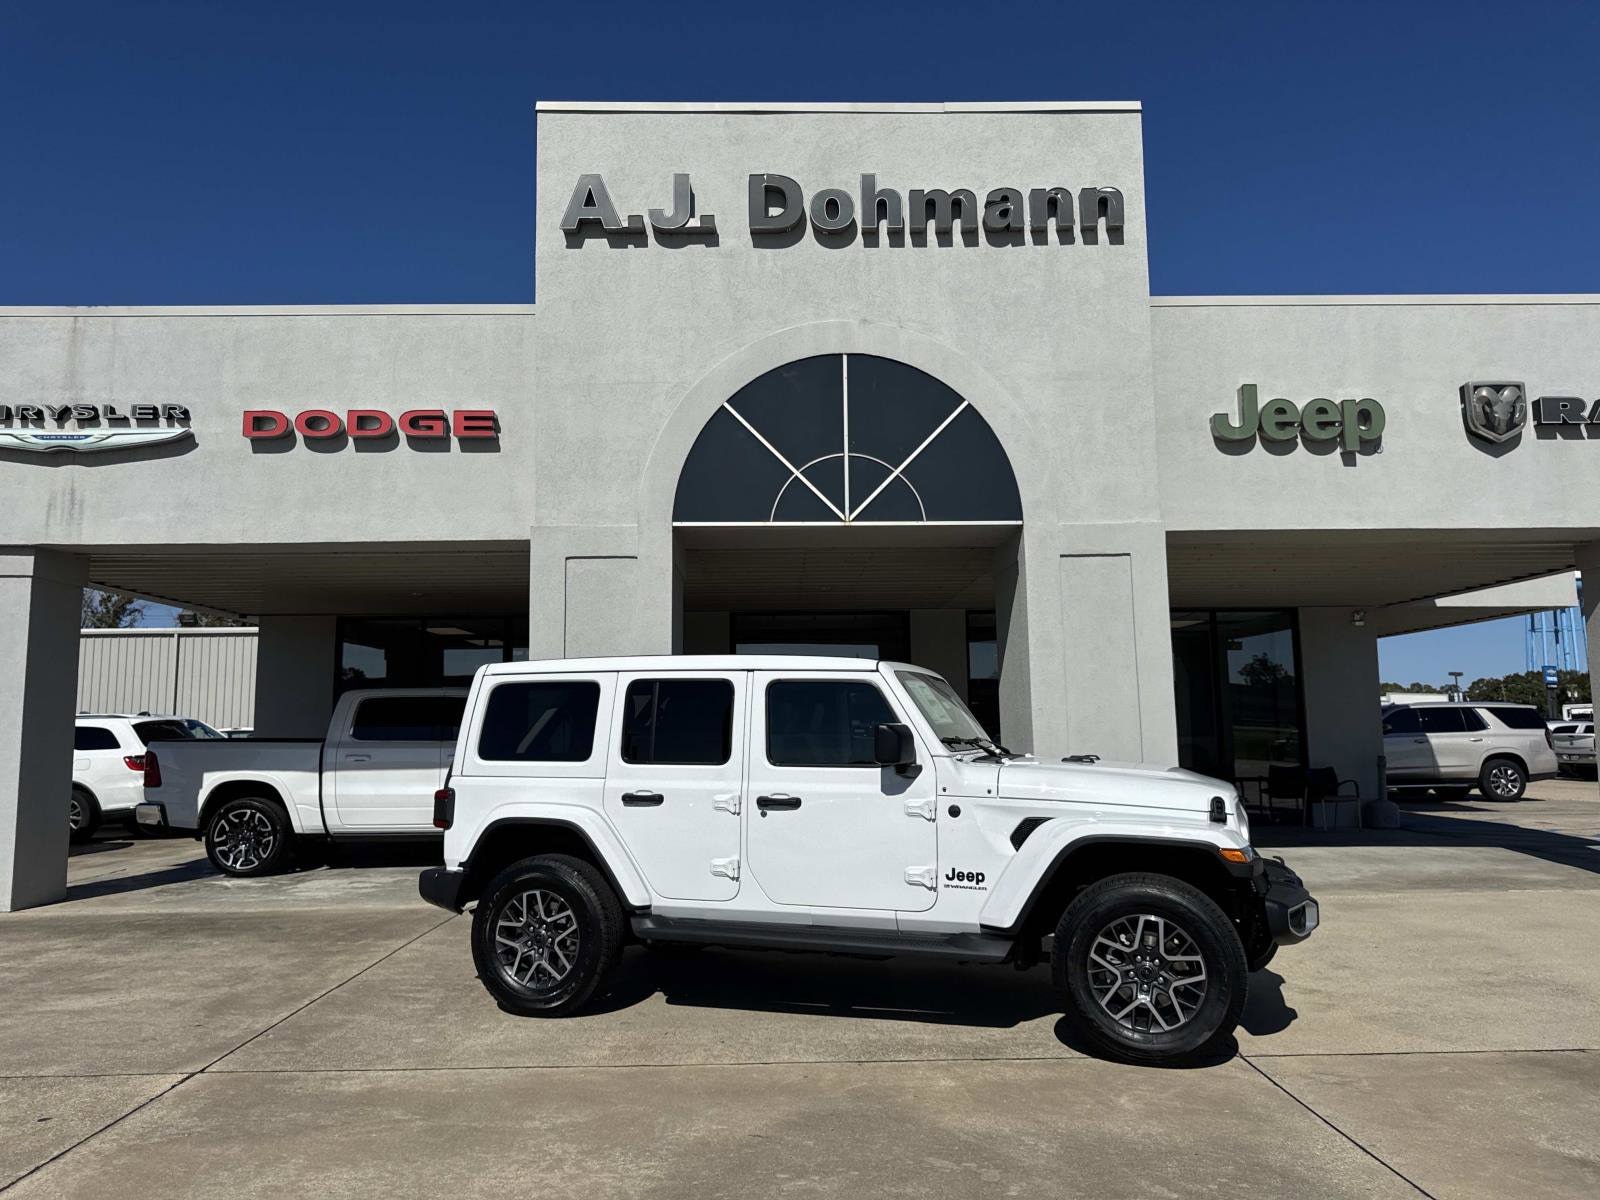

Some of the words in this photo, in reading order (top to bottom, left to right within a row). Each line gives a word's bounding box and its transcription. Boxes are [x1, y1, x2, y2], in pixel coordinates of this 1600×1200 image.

[559, 173, 718, 234] A.J.
[748, 173, 1126, 235] Dohmann
[242, 410, 499, 439] DODGE
[1210, 383, 1386, 452] Jeep
[1532, 396, 1600, 424] R
[945, 867, 985, 885] Jeep
